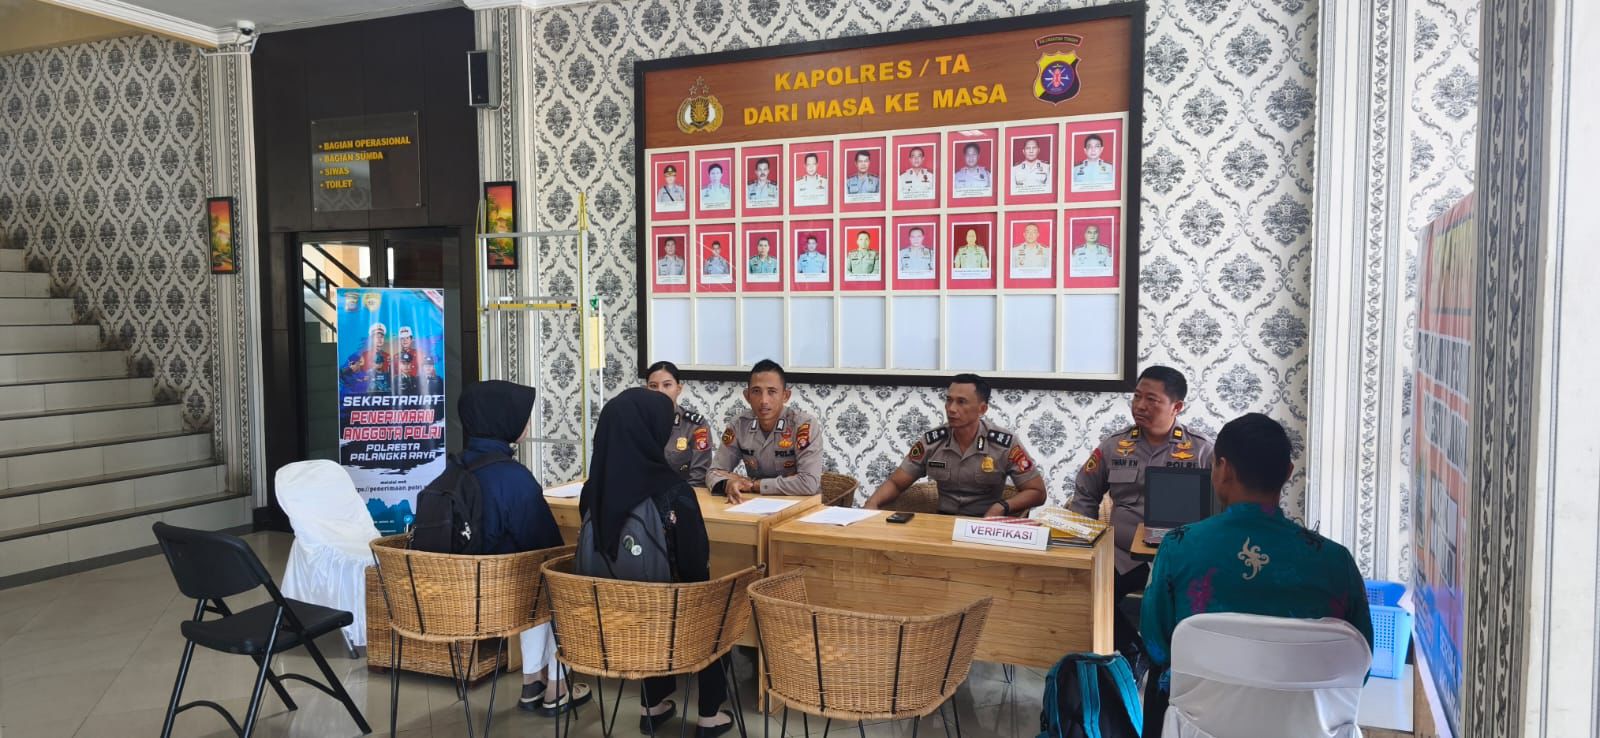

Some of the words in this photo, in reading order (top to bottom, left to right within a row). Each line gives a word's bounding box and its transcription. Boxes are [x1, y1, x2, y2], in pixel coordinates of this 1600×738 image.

[775, 60, 912, 92] KAPOLRES
[919, 58, 930, 78] /
[935, 53, 971, 76] TA
[744, 103, 798, 126] DARI
[806, 96, 876, 120] MASA
[885, 92, 920, 113] KE
[932, 83, 1008, 109] MASA
[323, 140, 354, 151] BAGIAN
[354, 136, 411, 148] OPERASIONAL
[324, 153, 354, 163] BAGIAN
[355, 151, 384, 160] SUMDA
[324, 167, 350, 176] SIWAS
[325, 179, 353, 189] TOILET
[343, 395, 442, 407] SEKRETARIAT
[350, 409, 435, 424] PENERIMAAN
[343, 426, 403, 441] ANGGOTA
[403, 426, 442, 440] POLRI
[366, 443, 420, 452] POLRESTA
[350, 452, 408, 461] PALANGKA
[408, 451, 437, 460] RAYA
[970, 525, 1033, 541] VERIFIKASI
